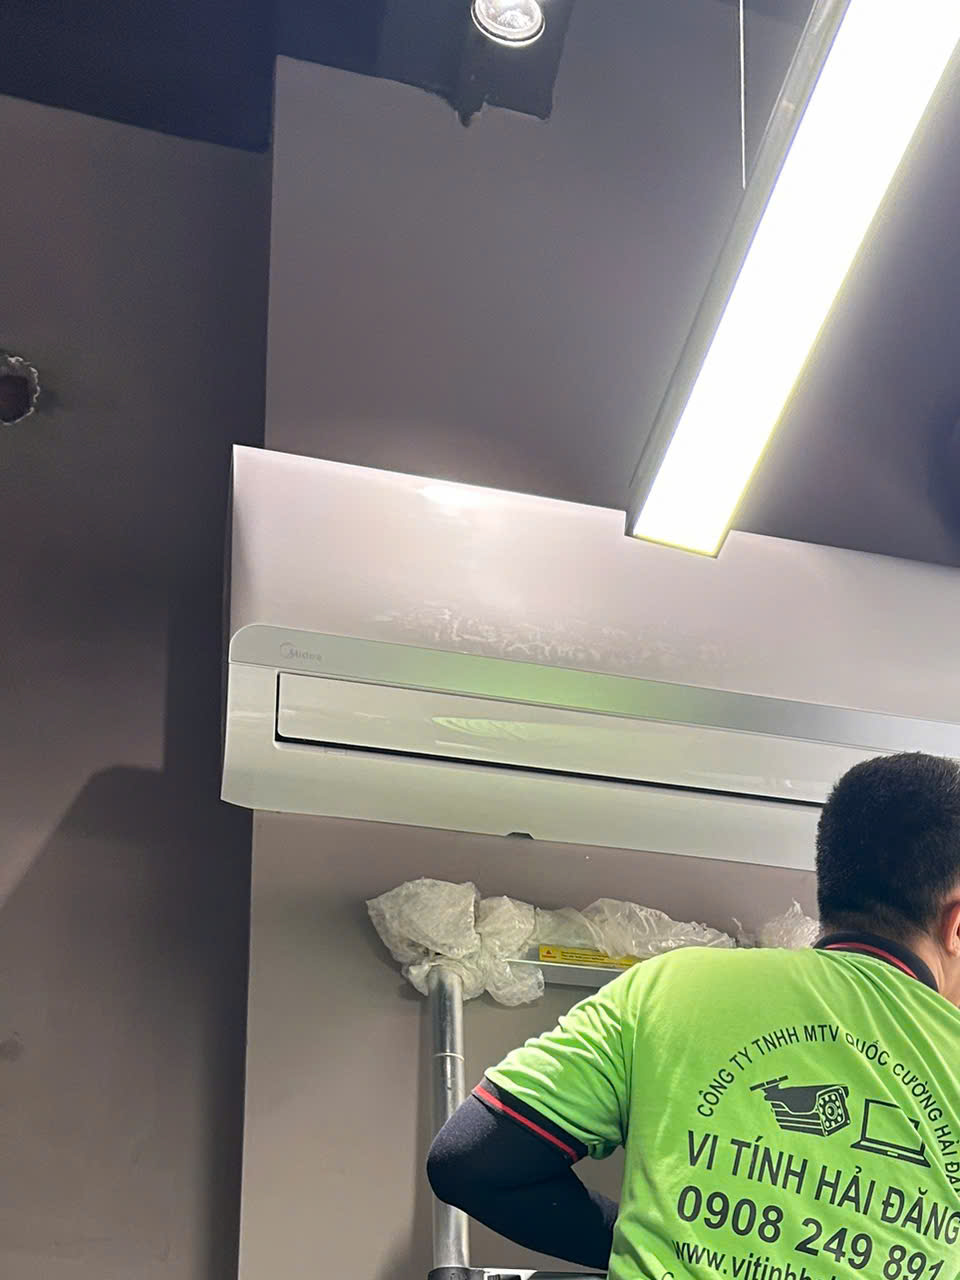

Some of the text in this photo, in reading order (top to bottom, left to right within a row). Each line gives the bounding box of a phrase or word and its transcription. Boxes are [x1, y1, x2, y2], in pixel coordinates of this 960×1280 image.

[697, 1068, 735, 1118] CÔNG
[729, 1048, 753, 1073] TY
[751, 1027, 800, 1057] TNHH
[804, 1024, 840, 1043] MTV
[845, 1032, 891, 1067] QUỐC
[892, 1062, 943, 1122] CƯỜNG
[687, 1130, 718, 1170] VI
[730, 1135, 808, 1194] TÍNH
[814, 1165, 876, 1216] HẢI
[676, 1185, 784, 1243] 0908
[794, 1217, 873, 1271] 249
